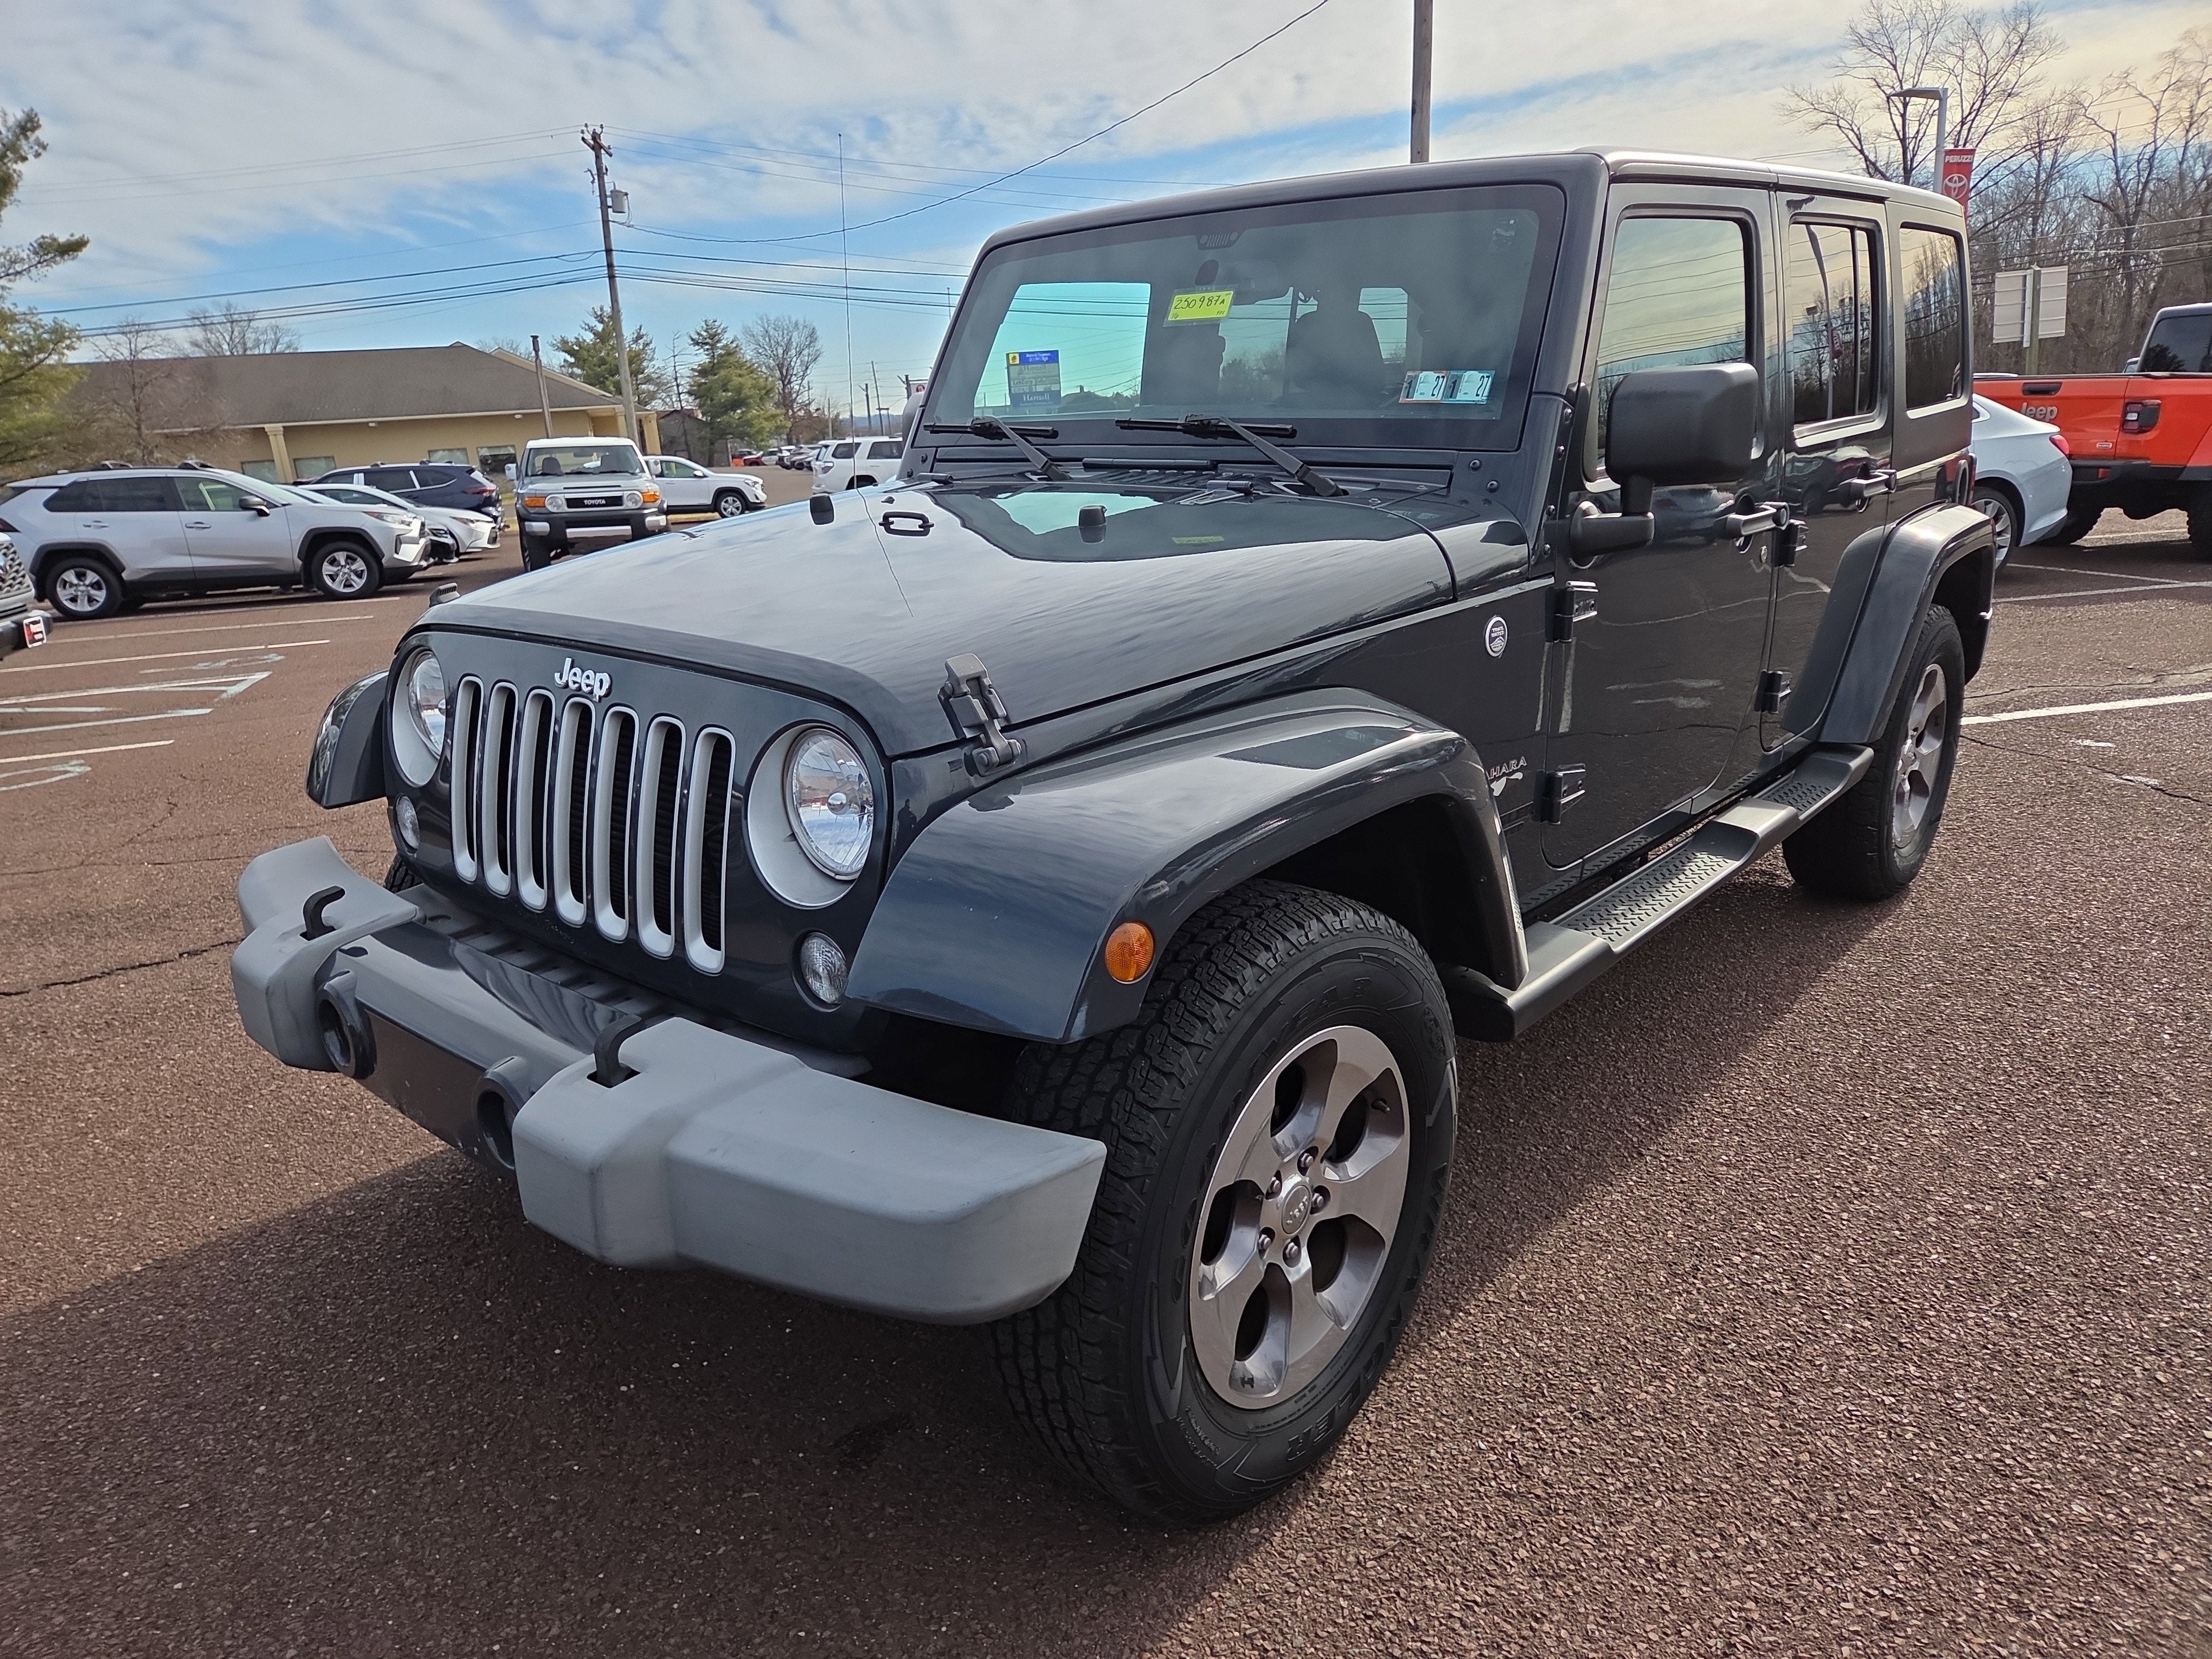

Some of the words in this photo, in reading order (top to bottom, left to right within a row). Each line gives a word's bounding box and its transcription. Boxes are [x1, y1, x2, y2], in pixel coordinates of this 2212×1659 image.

[1431, 375, 1445, 397] 27
[1475, 375, 1490, 397] 27
[554, 657, 612, 703] Jeep
[1486, 755, 1527, 780] HARA
